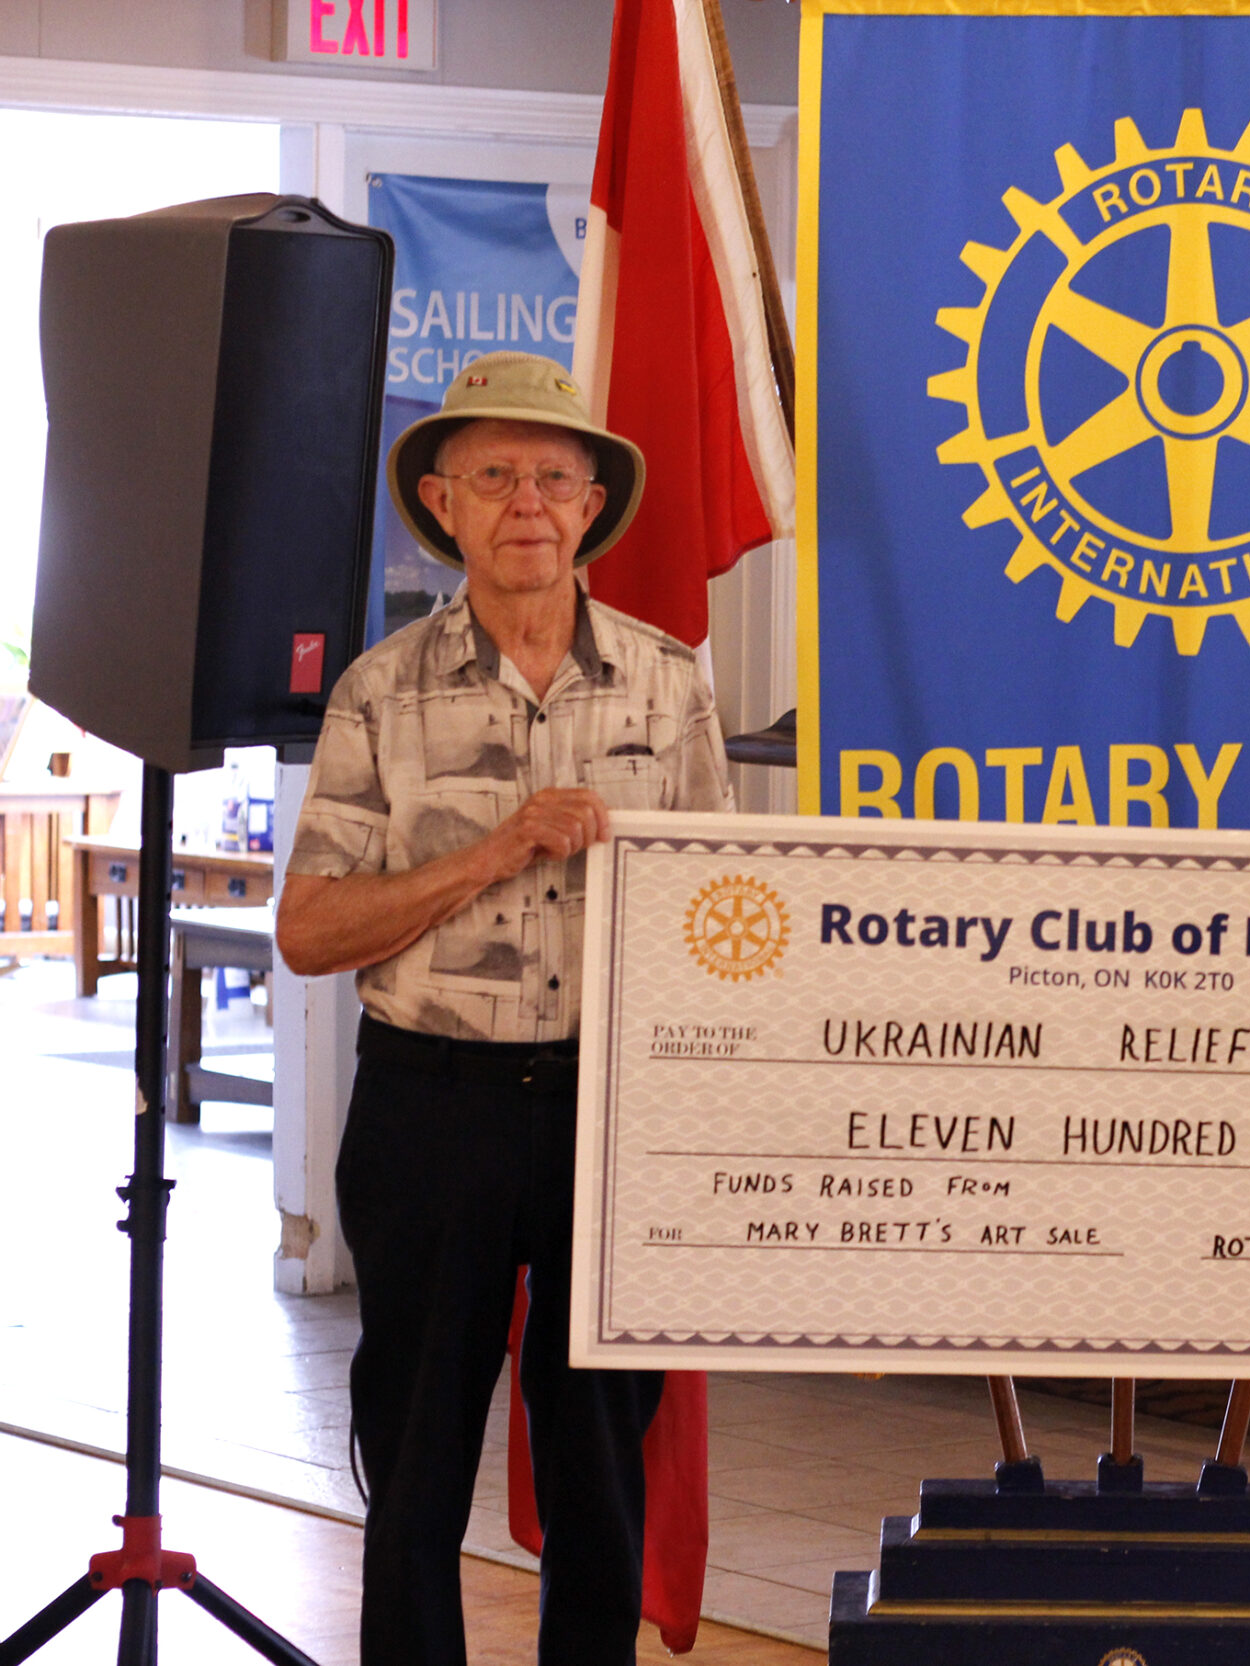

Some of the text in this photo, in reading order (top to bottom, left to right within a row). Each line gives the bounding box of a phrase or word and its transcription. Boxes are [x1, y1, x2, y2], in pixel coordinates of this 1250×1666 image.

[390, 287, 578, 343] SAILING
[839, 742, 1243, 831] ROTARY
[820, 903, 1013, 962] Rotary
[1030, 908, 1153, 954] Club
[1172, 913, 1230, 956] of
[1009, 965, 1087, 991] Picton,
[1094, 968, 1130, 988] ON
[653, 1024, 758, 1040] PAY TO THE
[823, 1018, 1043, 1058] UKRAINIAN
[651, 1041, 741, 1056] ORDER OF
[848, 1111, 1015, 1153] ELEVEN
[1063, 1116, 1236, 1156] HUNDRED
[713, 1172, 794, 1194] FUNDS
[820, 1174, 914, 1198] RAISED
[649, 1226, 683, 1241] FOR
[747, 1218, 1101, 1246] MARY BRETT'S ART SALE
